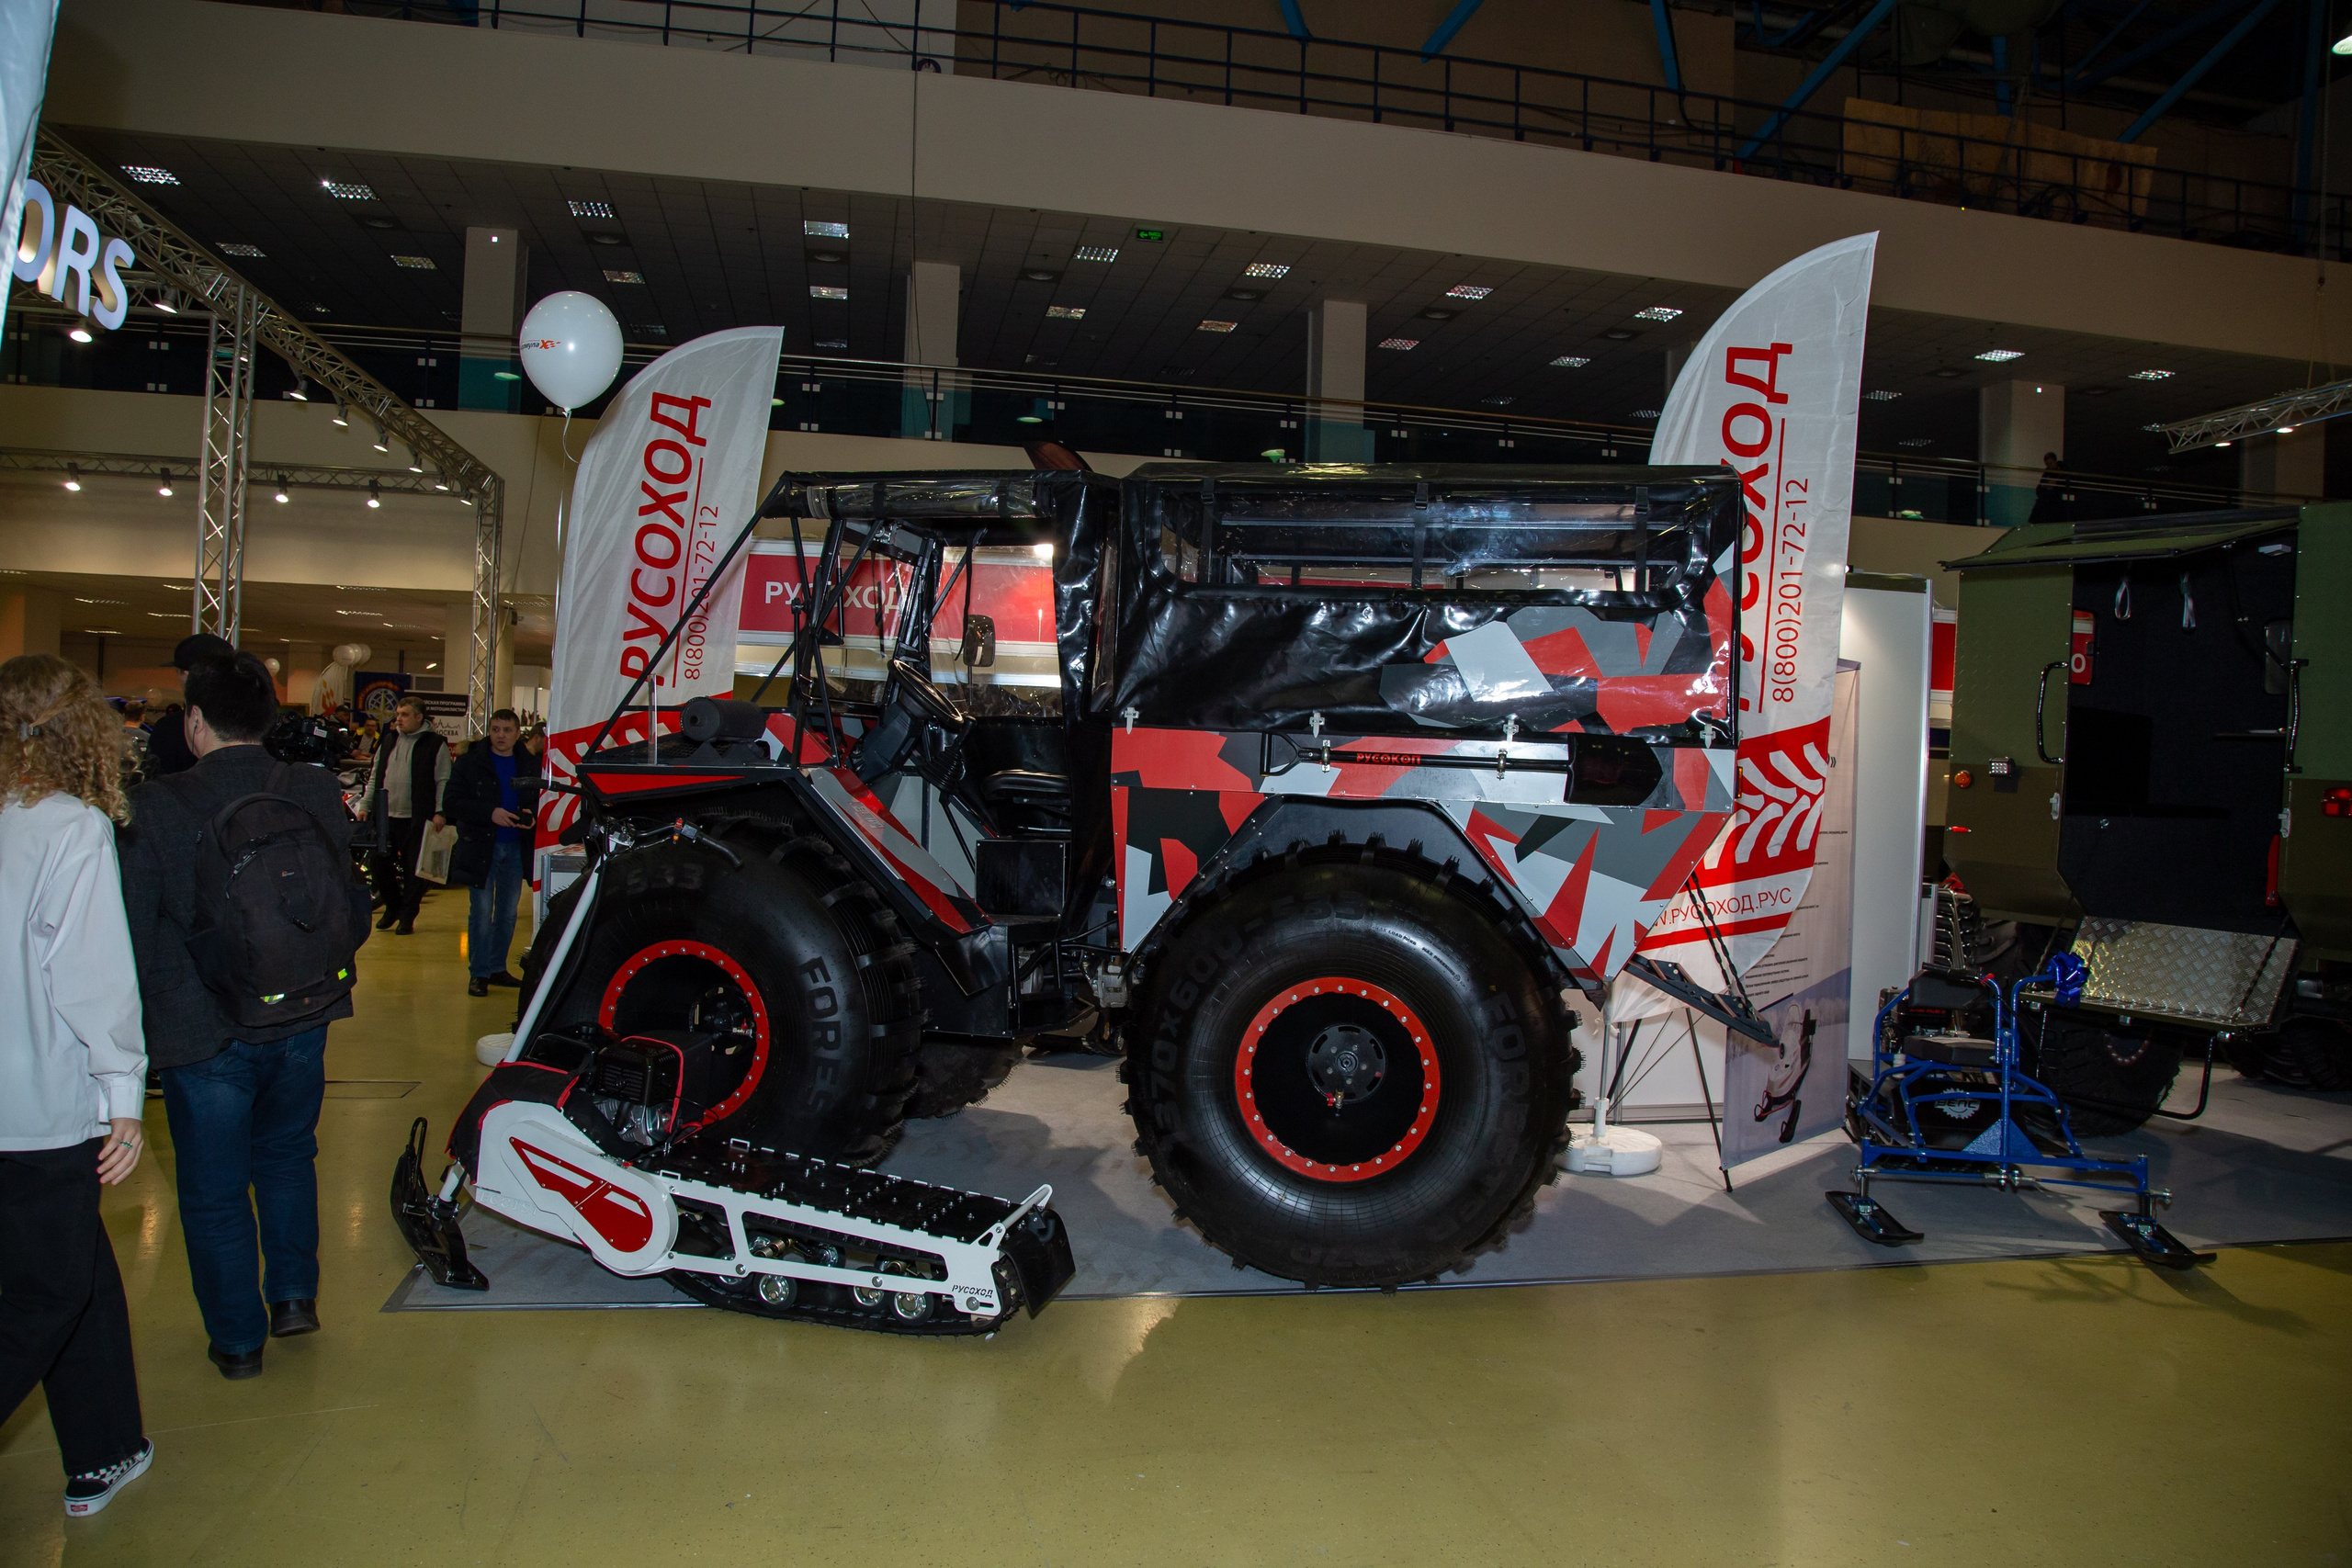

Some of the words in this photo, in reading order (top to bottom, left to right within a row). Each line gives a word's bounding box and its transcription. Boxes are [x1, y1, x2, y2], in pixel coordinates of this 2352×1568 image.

[620, 391, 711, 686] РУСОХОД
[765, 581, 905, 614] РУХОД
[1771, 479, 1808, 703] 8(800)201-72-12
[1356, 752, 1421, 765] РУСОКОП
[951, 1284, 993, 1298] РУСОХОД
